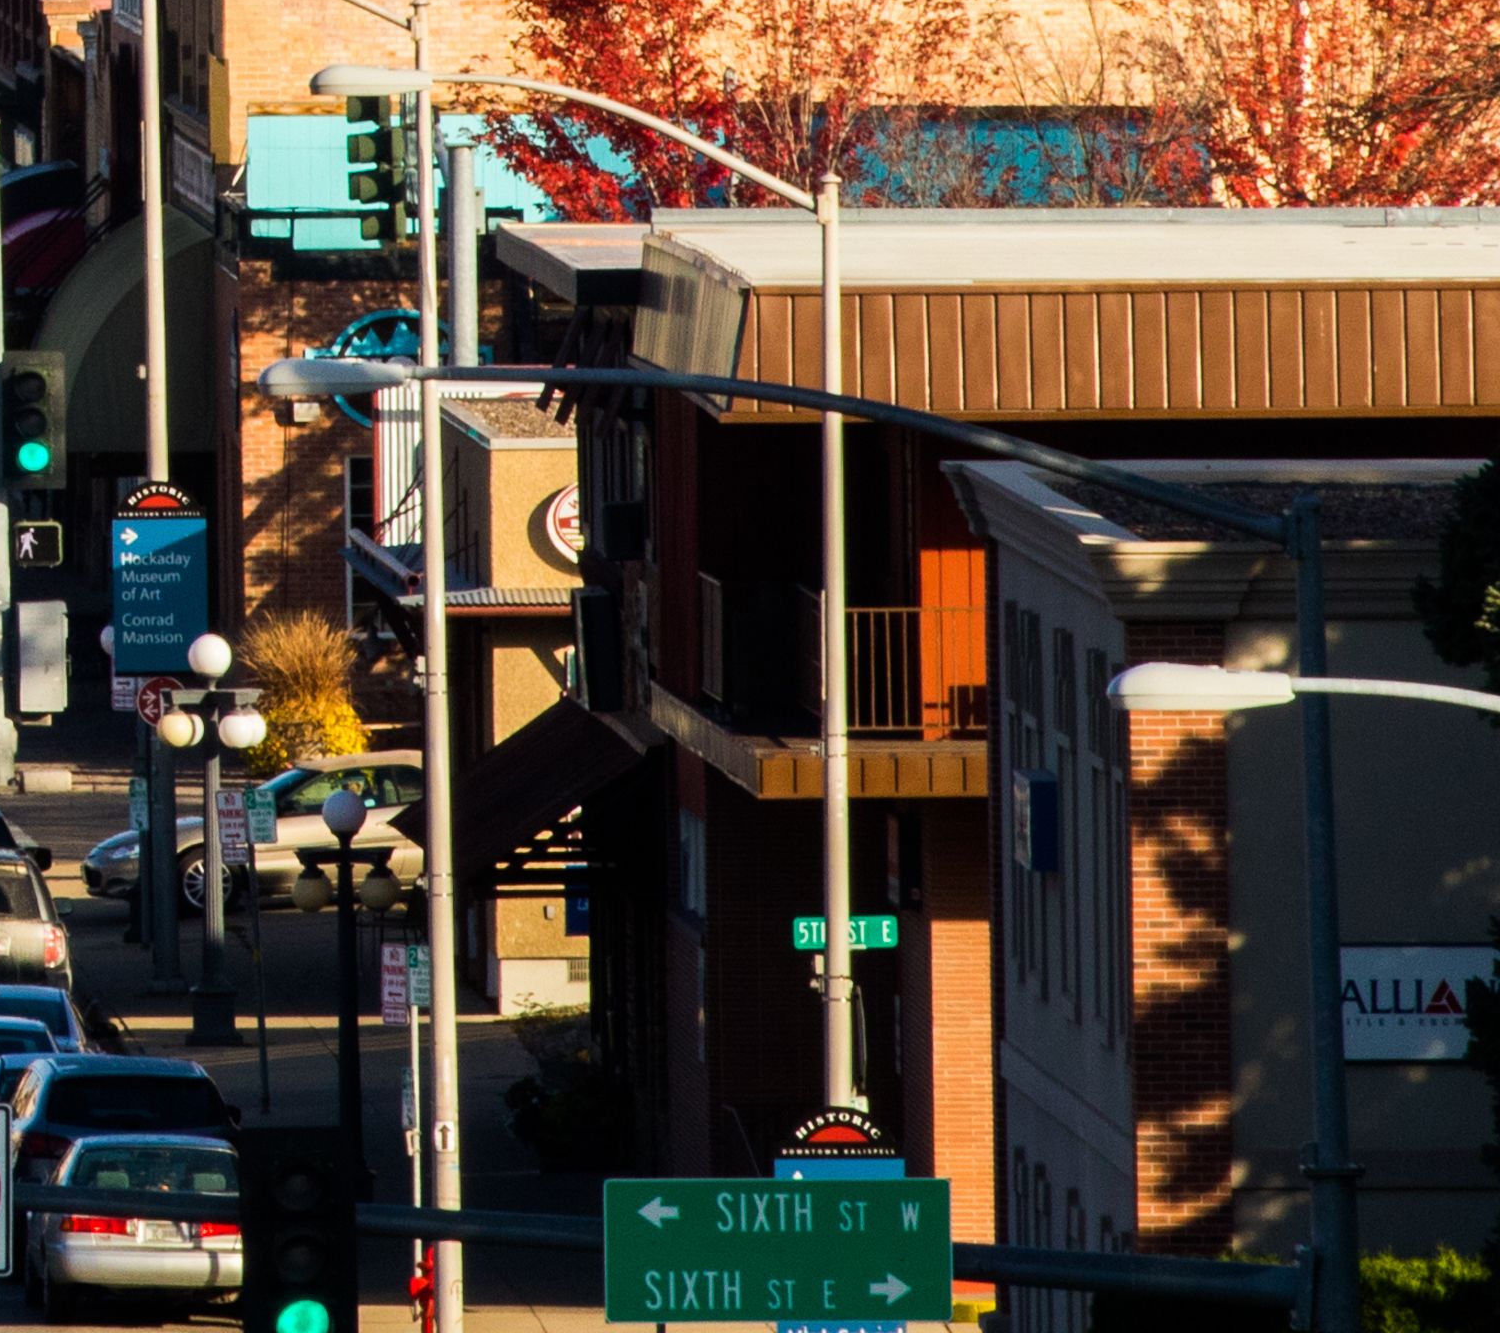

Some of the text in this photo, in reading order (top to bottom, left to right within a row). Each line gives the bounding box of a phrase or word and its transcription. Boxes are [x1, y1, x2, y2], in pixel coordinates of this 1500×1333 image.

[127, 485, 190, 507] HISTORIC
[120, 551, 191, 569] Hockaday
[121, 570, 181, 583] Museum
[121, 587, 161, 601] of Art
[122, 612, 174, 627] Conrad
[123, 631, 184, 644] Mansion
[846, 920, 867, 943] ST
[882, 920, 892, 943] E
[795, 1112, 882, 1140] HISTORIC
[716, 1192, 921, 1232] SIXTH ST W
[644, 1270, 836, 1310] SIXTH ST E
